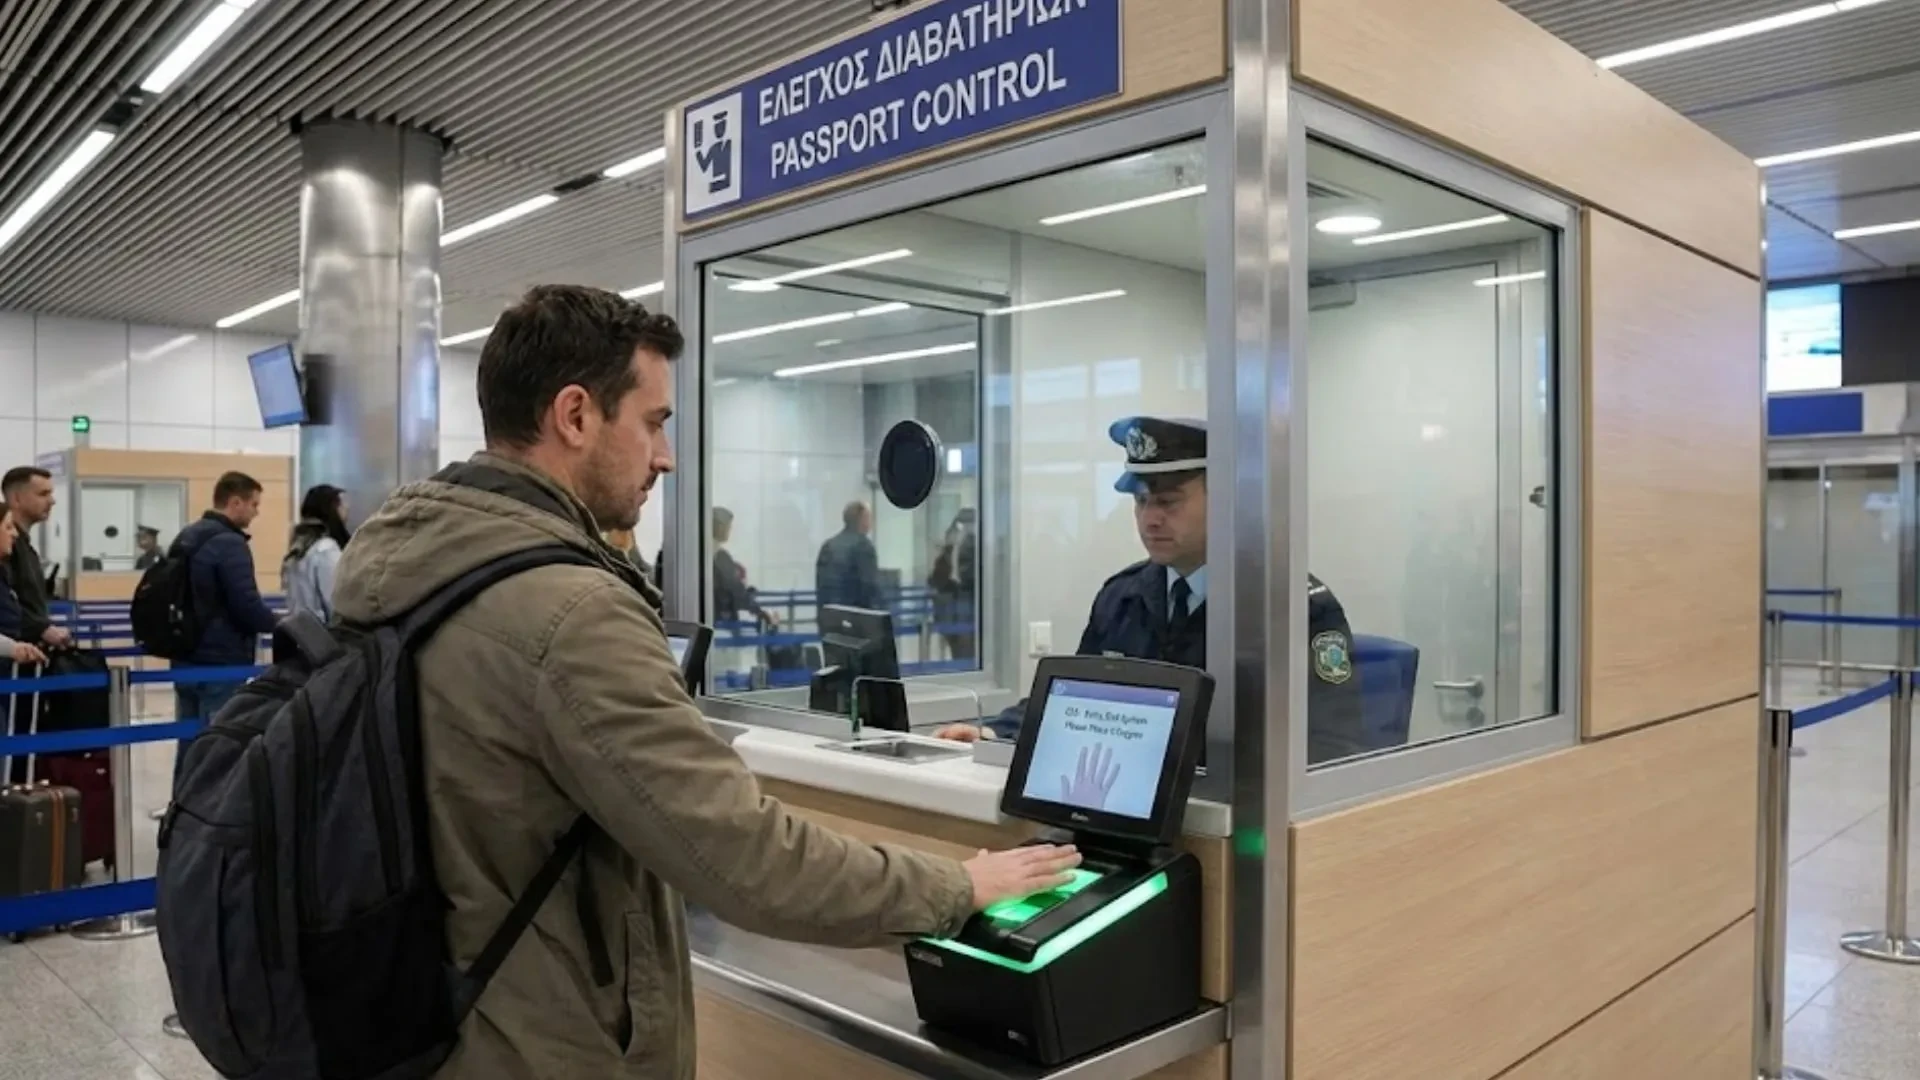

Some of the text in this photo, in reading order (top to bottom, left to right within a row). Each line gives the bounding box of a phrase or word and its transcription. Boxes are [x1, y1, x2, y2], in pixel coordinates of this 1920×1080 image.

[758, 0, 1087, 126] ΕΛΕΓΧΟΣ ΔΙΑΒΑΤΗΡΙΩ
[770, 47, 1067, 179] PASSPORT CONTROL
